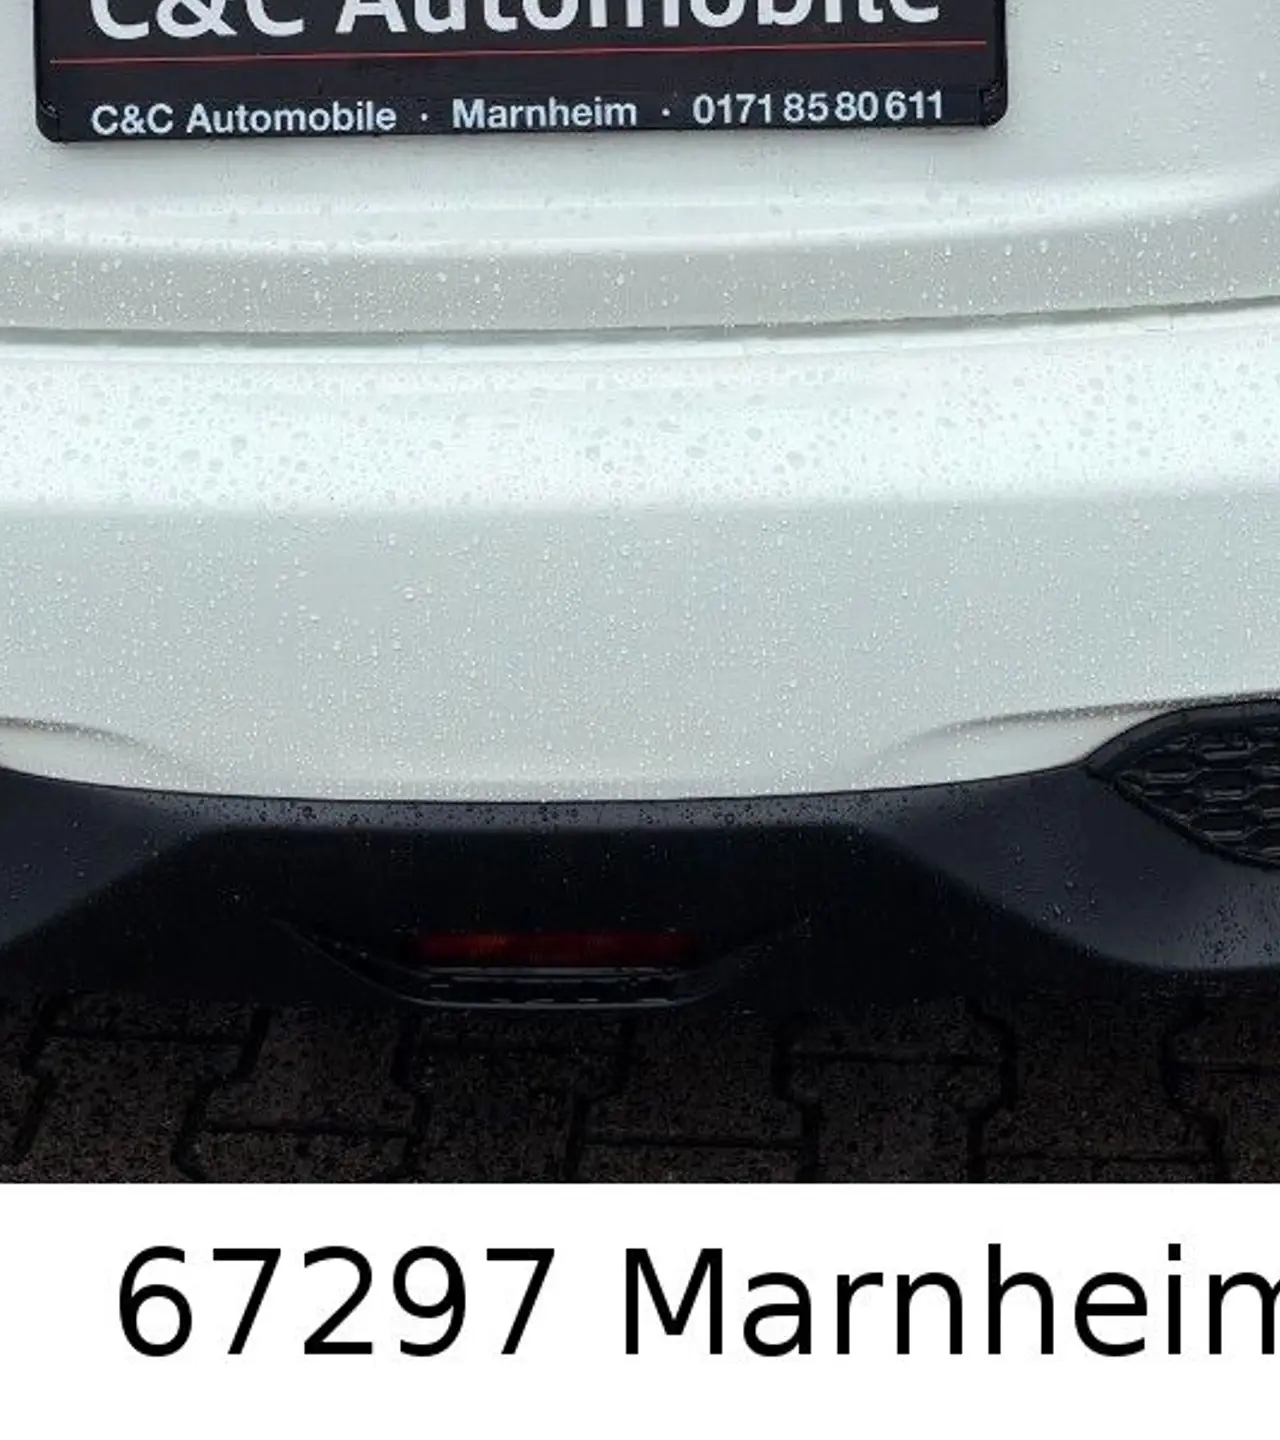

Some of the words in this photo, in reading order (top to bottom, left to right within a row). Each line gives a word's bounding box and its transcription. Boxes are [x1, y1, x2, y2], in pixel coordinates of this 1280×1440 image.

[91, 103, 174, 136] C&C
[185, 99, 398, 135] Automobile
[452, 94, 638, 129] Marnheim
